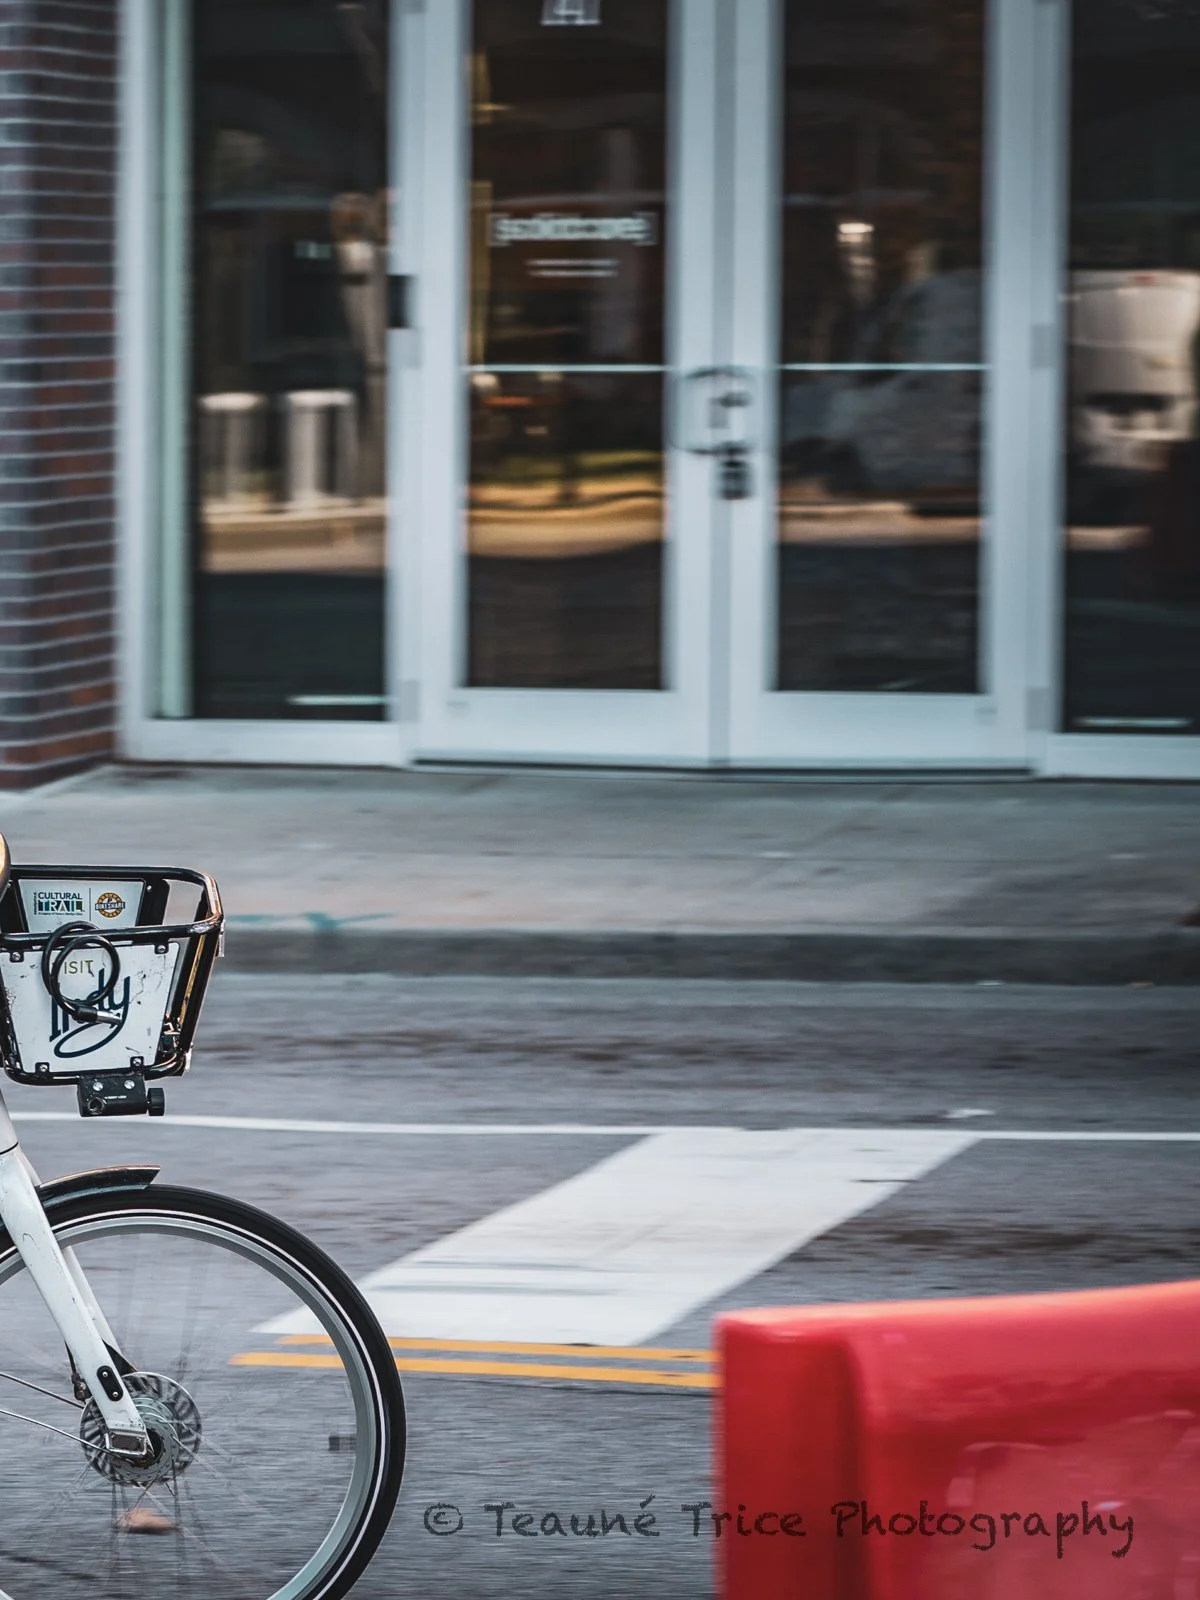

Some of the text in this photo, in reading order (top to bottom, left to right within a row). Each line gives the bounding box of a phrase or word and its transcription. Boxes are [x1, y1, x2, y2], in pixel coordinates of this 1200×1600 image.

[38, 892, 83, 900] CULTURAL
[38, 900, 83, 913] TRAIL
[63, 960, 94, 975] ISIT
